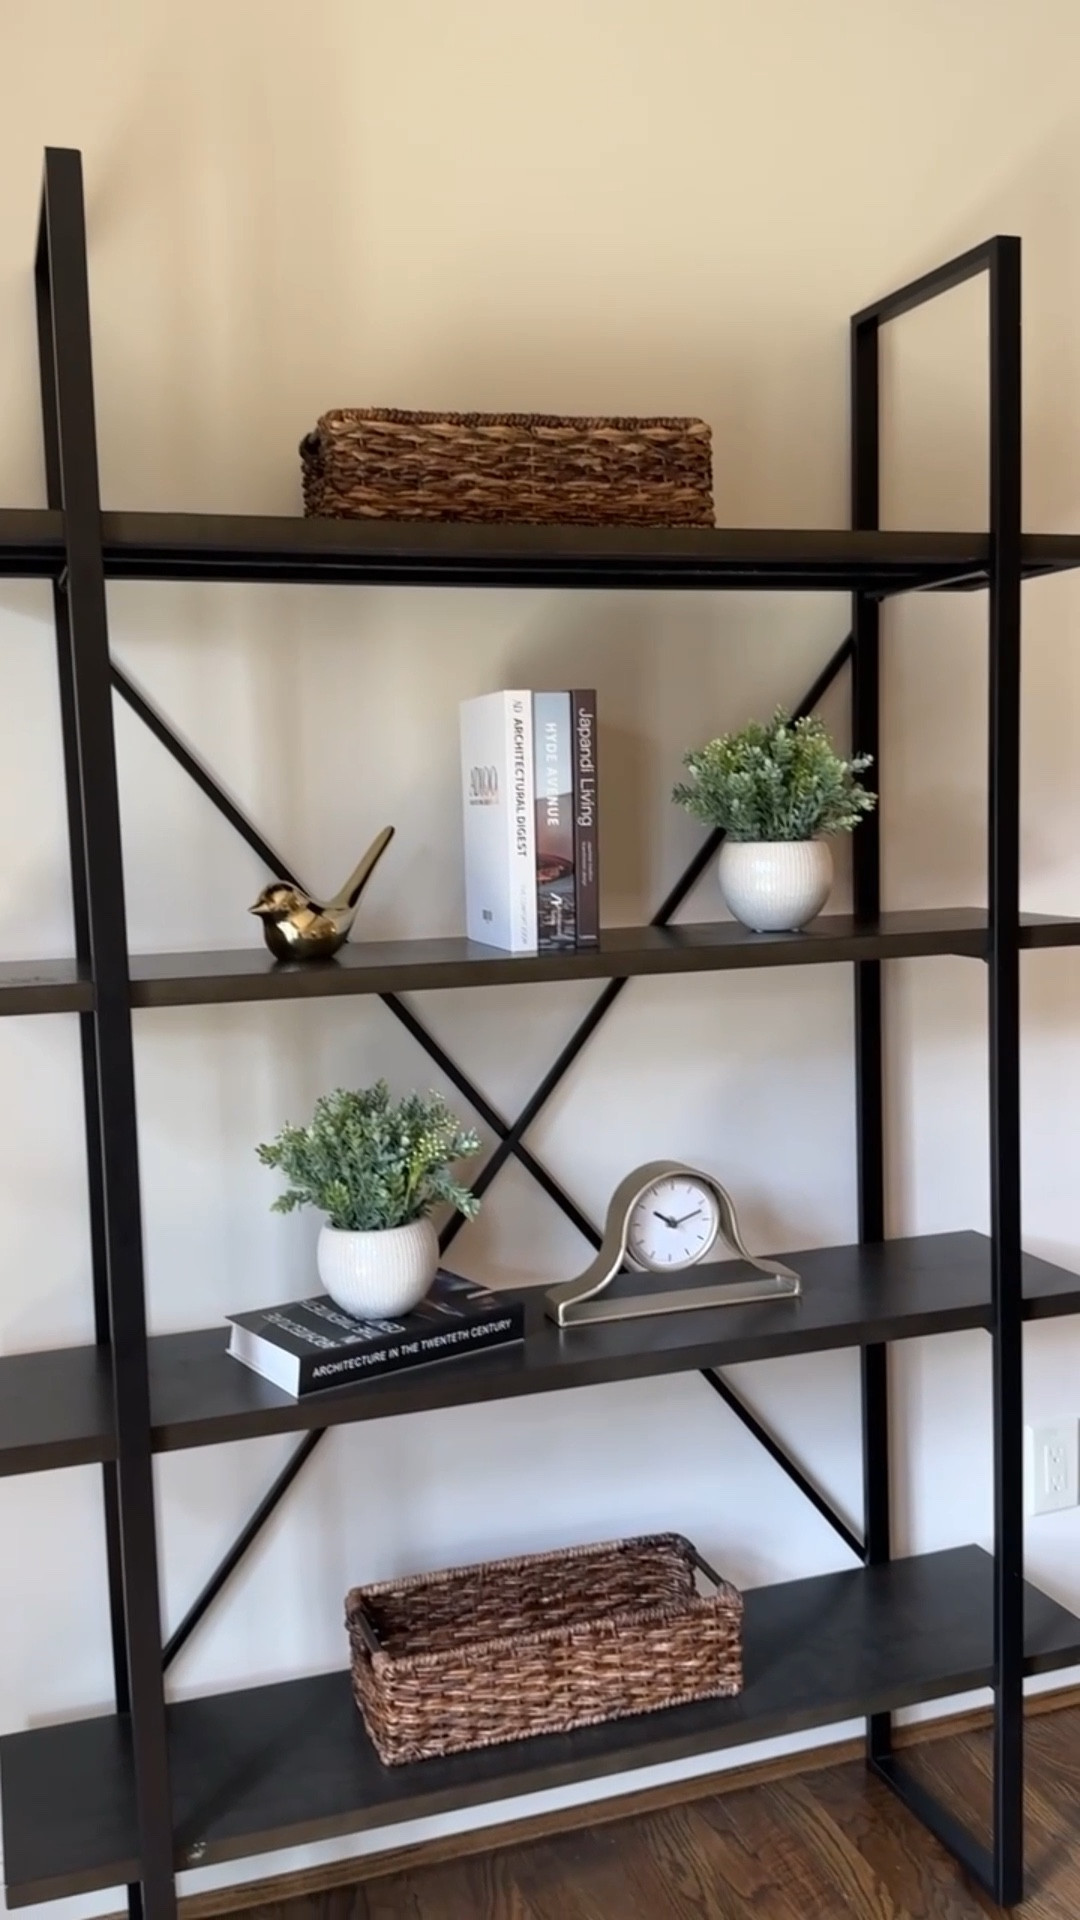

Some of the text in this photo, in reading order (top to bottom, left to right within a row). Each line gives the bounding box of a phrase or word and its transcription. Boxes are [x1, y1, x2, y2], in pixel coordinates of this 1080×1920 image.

[513, 717, 527, 814] ARCHITECTURAL
[545, 722, 560, 826] HYDE AVENUE
[577, 707, 595, 827] Japandi Living
[516, 815, 527, 857] DIGEST
[312, 1350, 387, 1378] ARCHITECTURE
[388, 1347, 400, 1359] IN
[401, 1341, 420, 1356] THE
[470, 1318, 512, 1338] CENTURY
